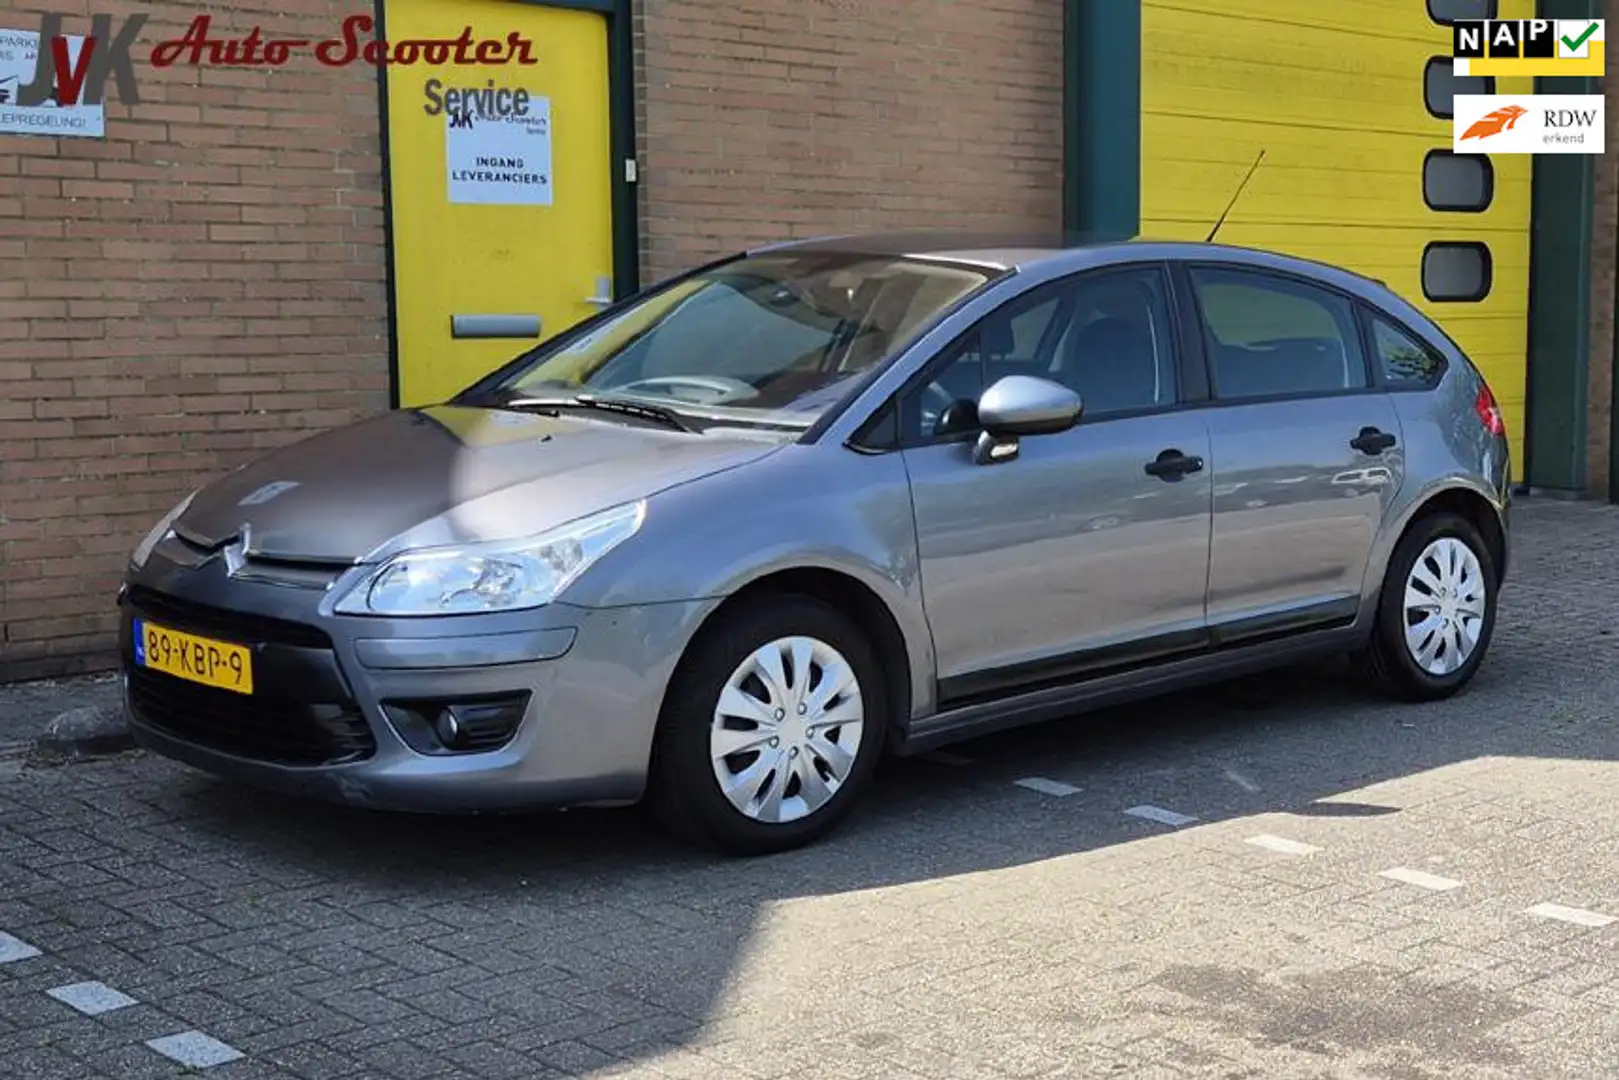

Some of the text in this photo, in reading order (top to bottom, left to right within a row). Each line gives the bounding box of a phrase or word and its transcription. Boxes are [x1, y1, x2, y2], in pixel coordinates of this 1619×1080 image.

[476, 156, 524, 169] INGANG
[452, 170, 547, 185] LEVERANCIERS
[148, 630, 243, 685] 89-KBP-9
